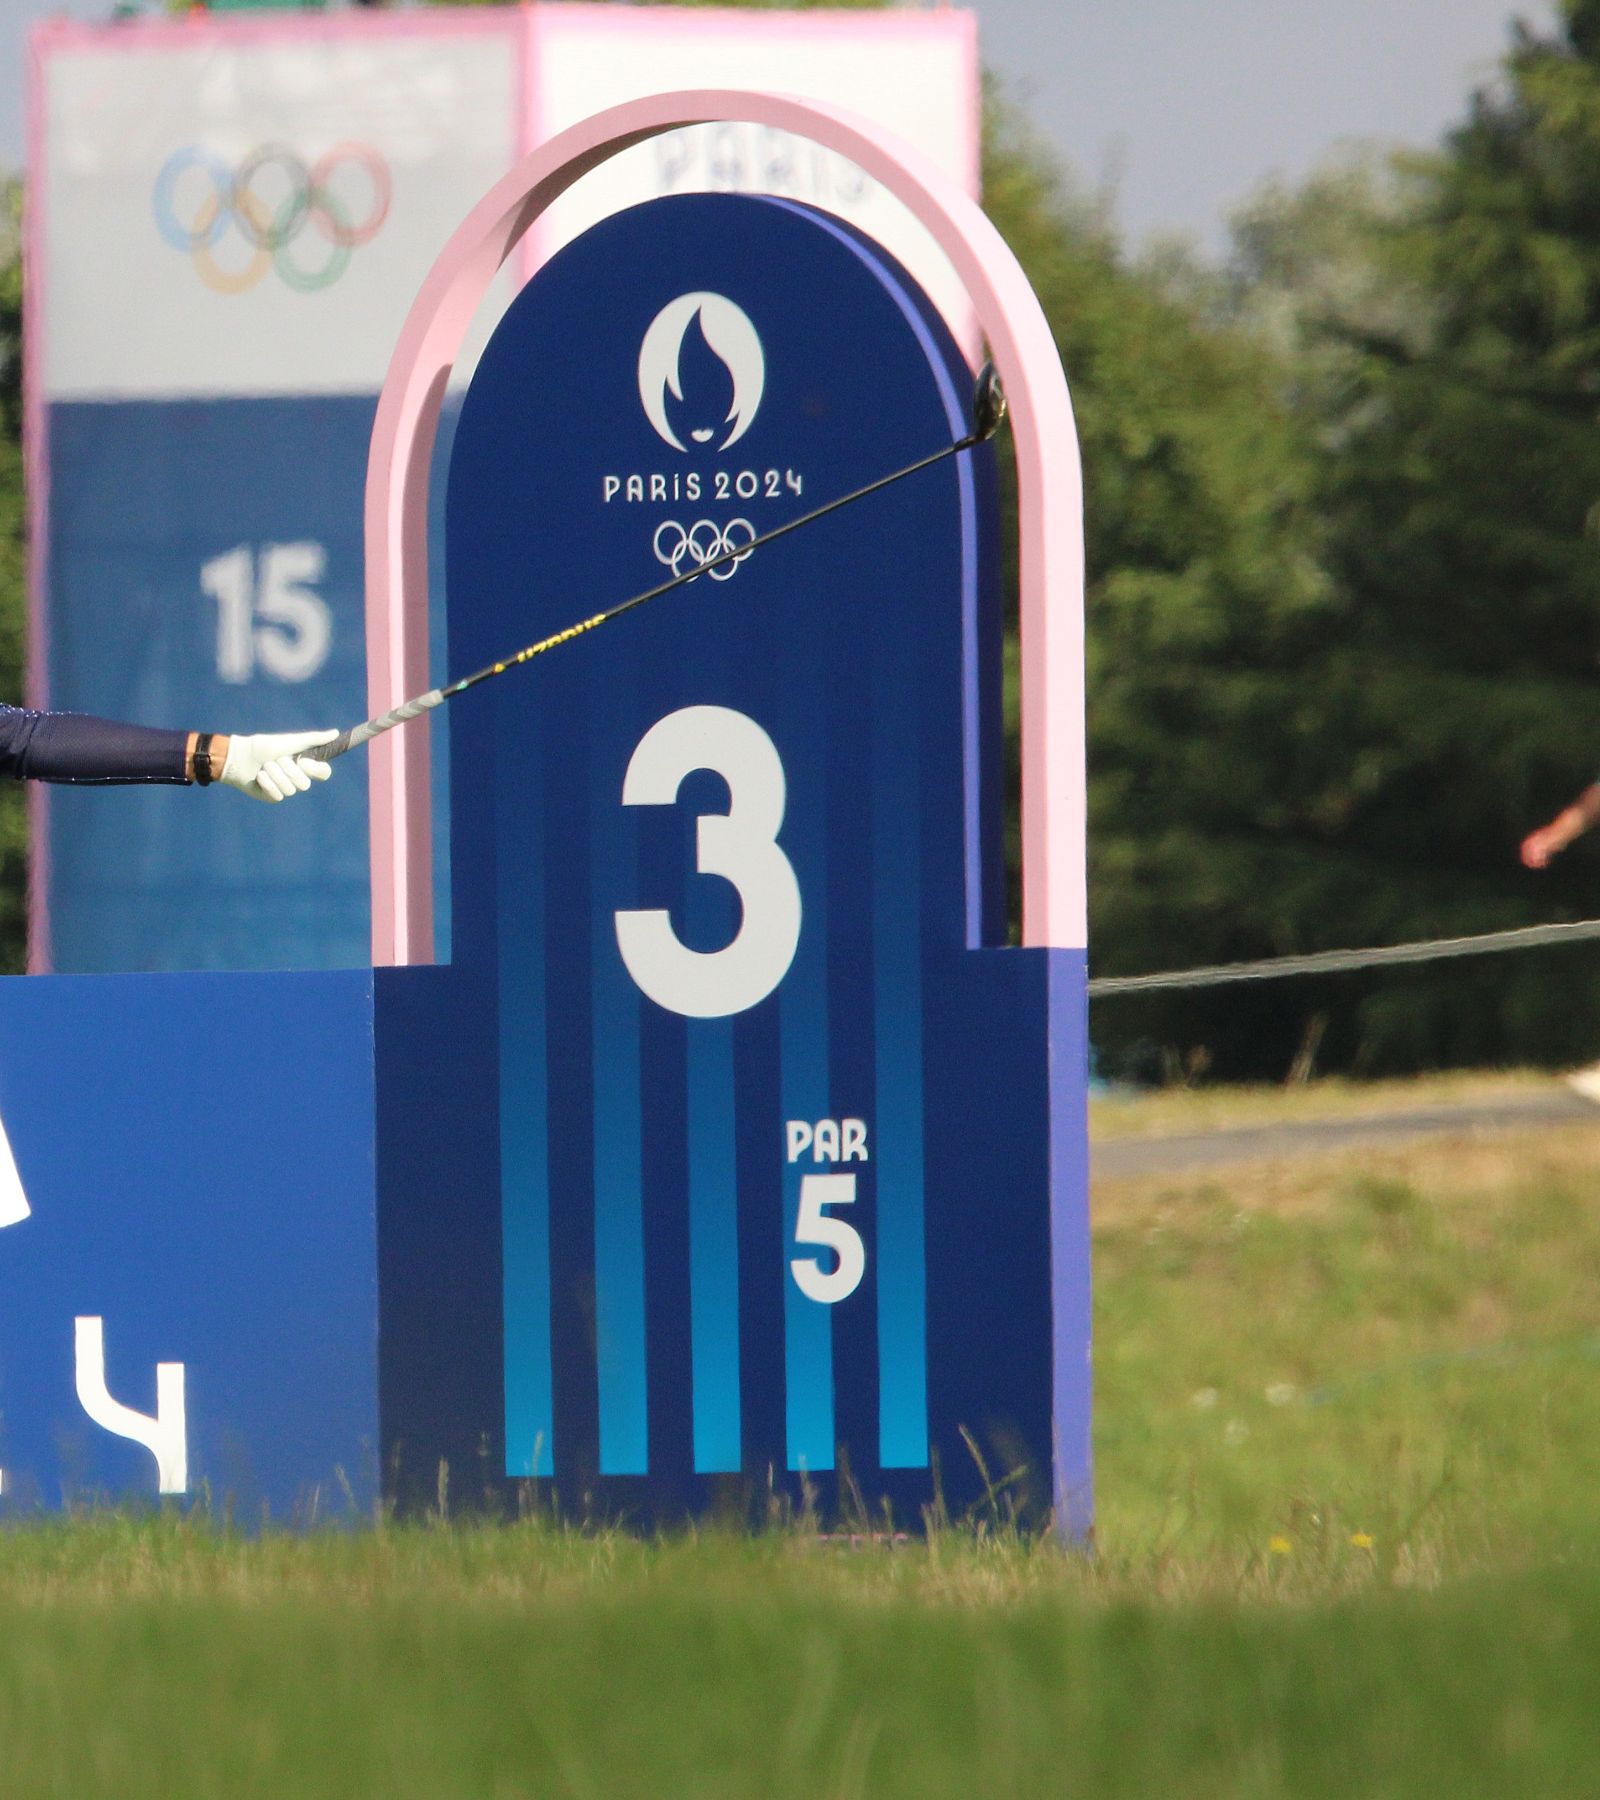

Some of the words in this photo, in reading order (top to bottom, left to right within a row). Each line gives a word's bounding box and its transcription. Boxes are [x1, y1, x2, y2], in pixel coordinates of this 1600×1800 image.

[714, 467, 803, 500] 2024
[198, 541, 333, 684] 15
[614, 705, 802, 1018] 3
[786, 1117, 868, 1164] PAR
[790, 1173, 865, 1303] 5
